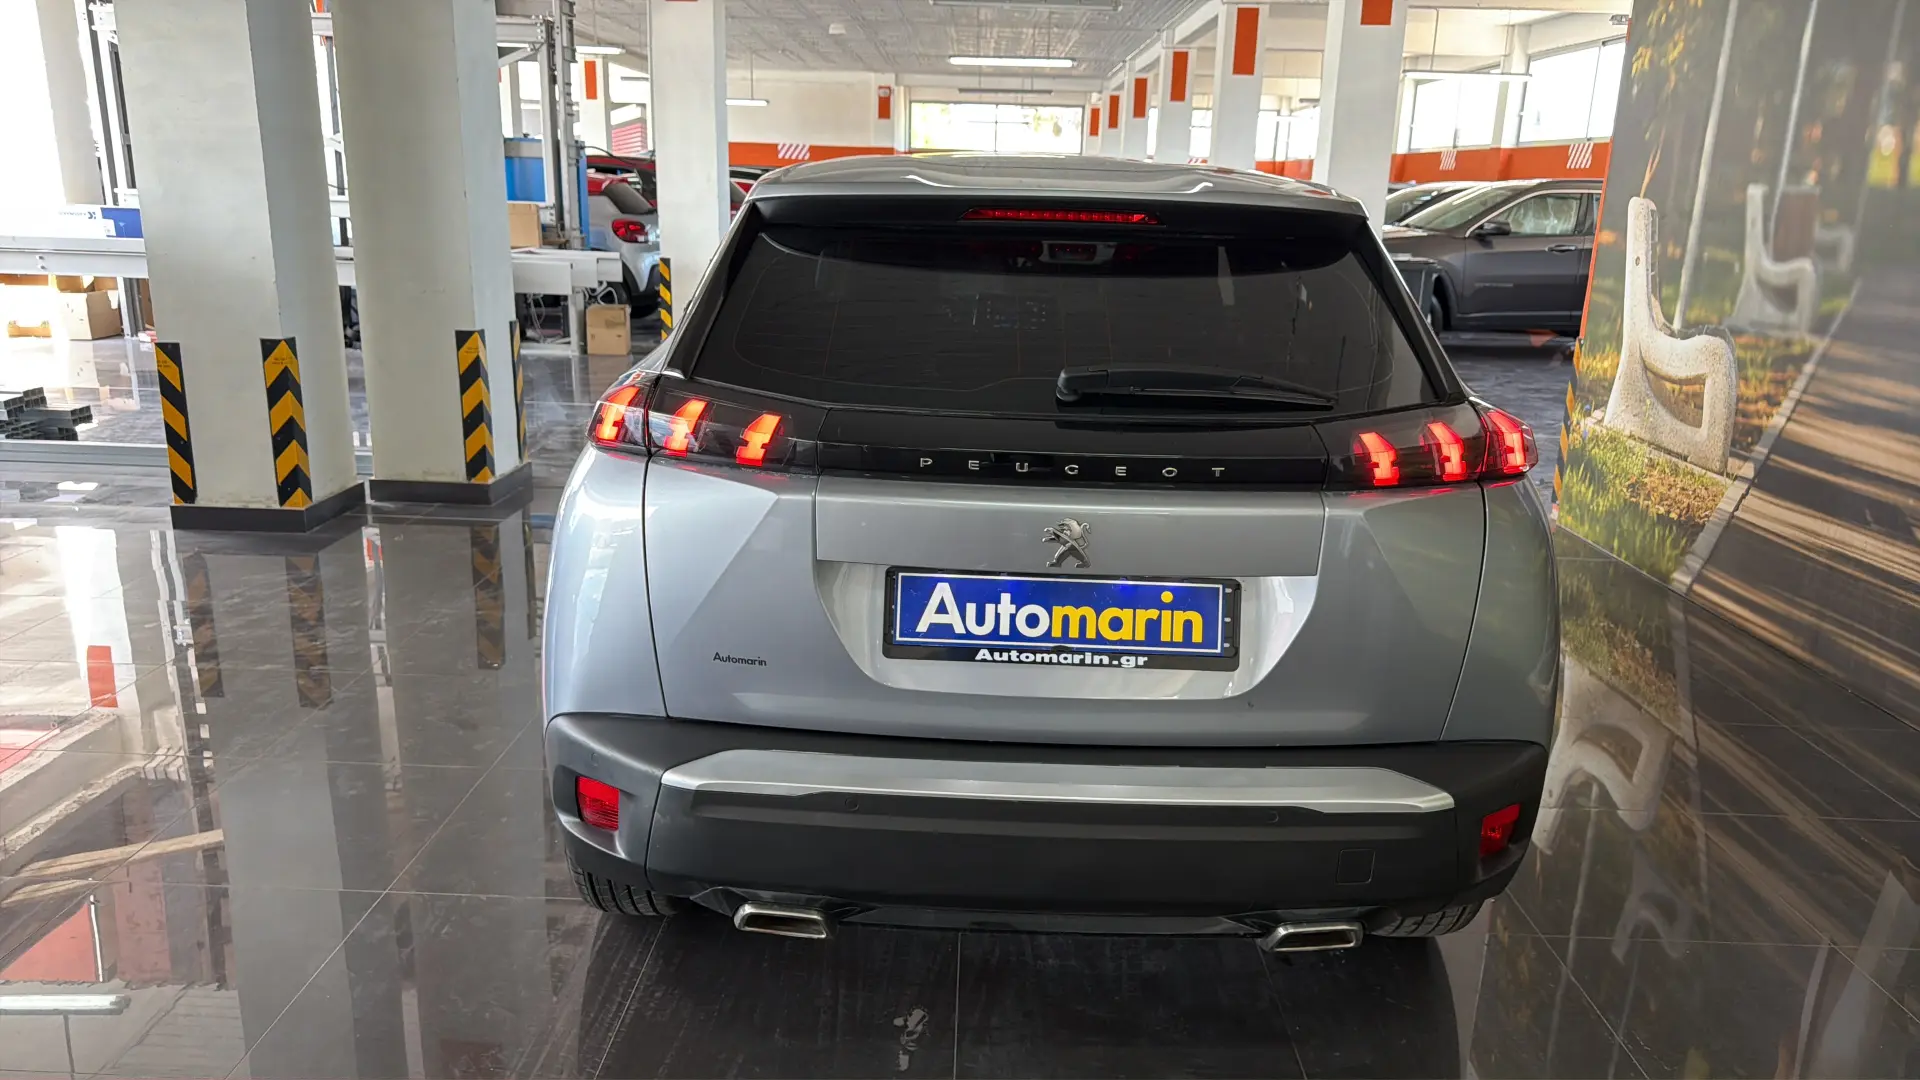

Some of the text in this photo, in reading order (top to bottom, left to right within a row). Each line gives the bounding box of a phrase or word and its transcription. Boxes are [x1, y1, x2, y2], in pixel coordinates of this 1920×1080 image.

[920, 457, 1225, 477] PEUGEOT
[915, 582, 1203, 643] Automarin
[713, 651, 767, 666] Automarin
[975, 648, 1149, 668] Automarin.gr
